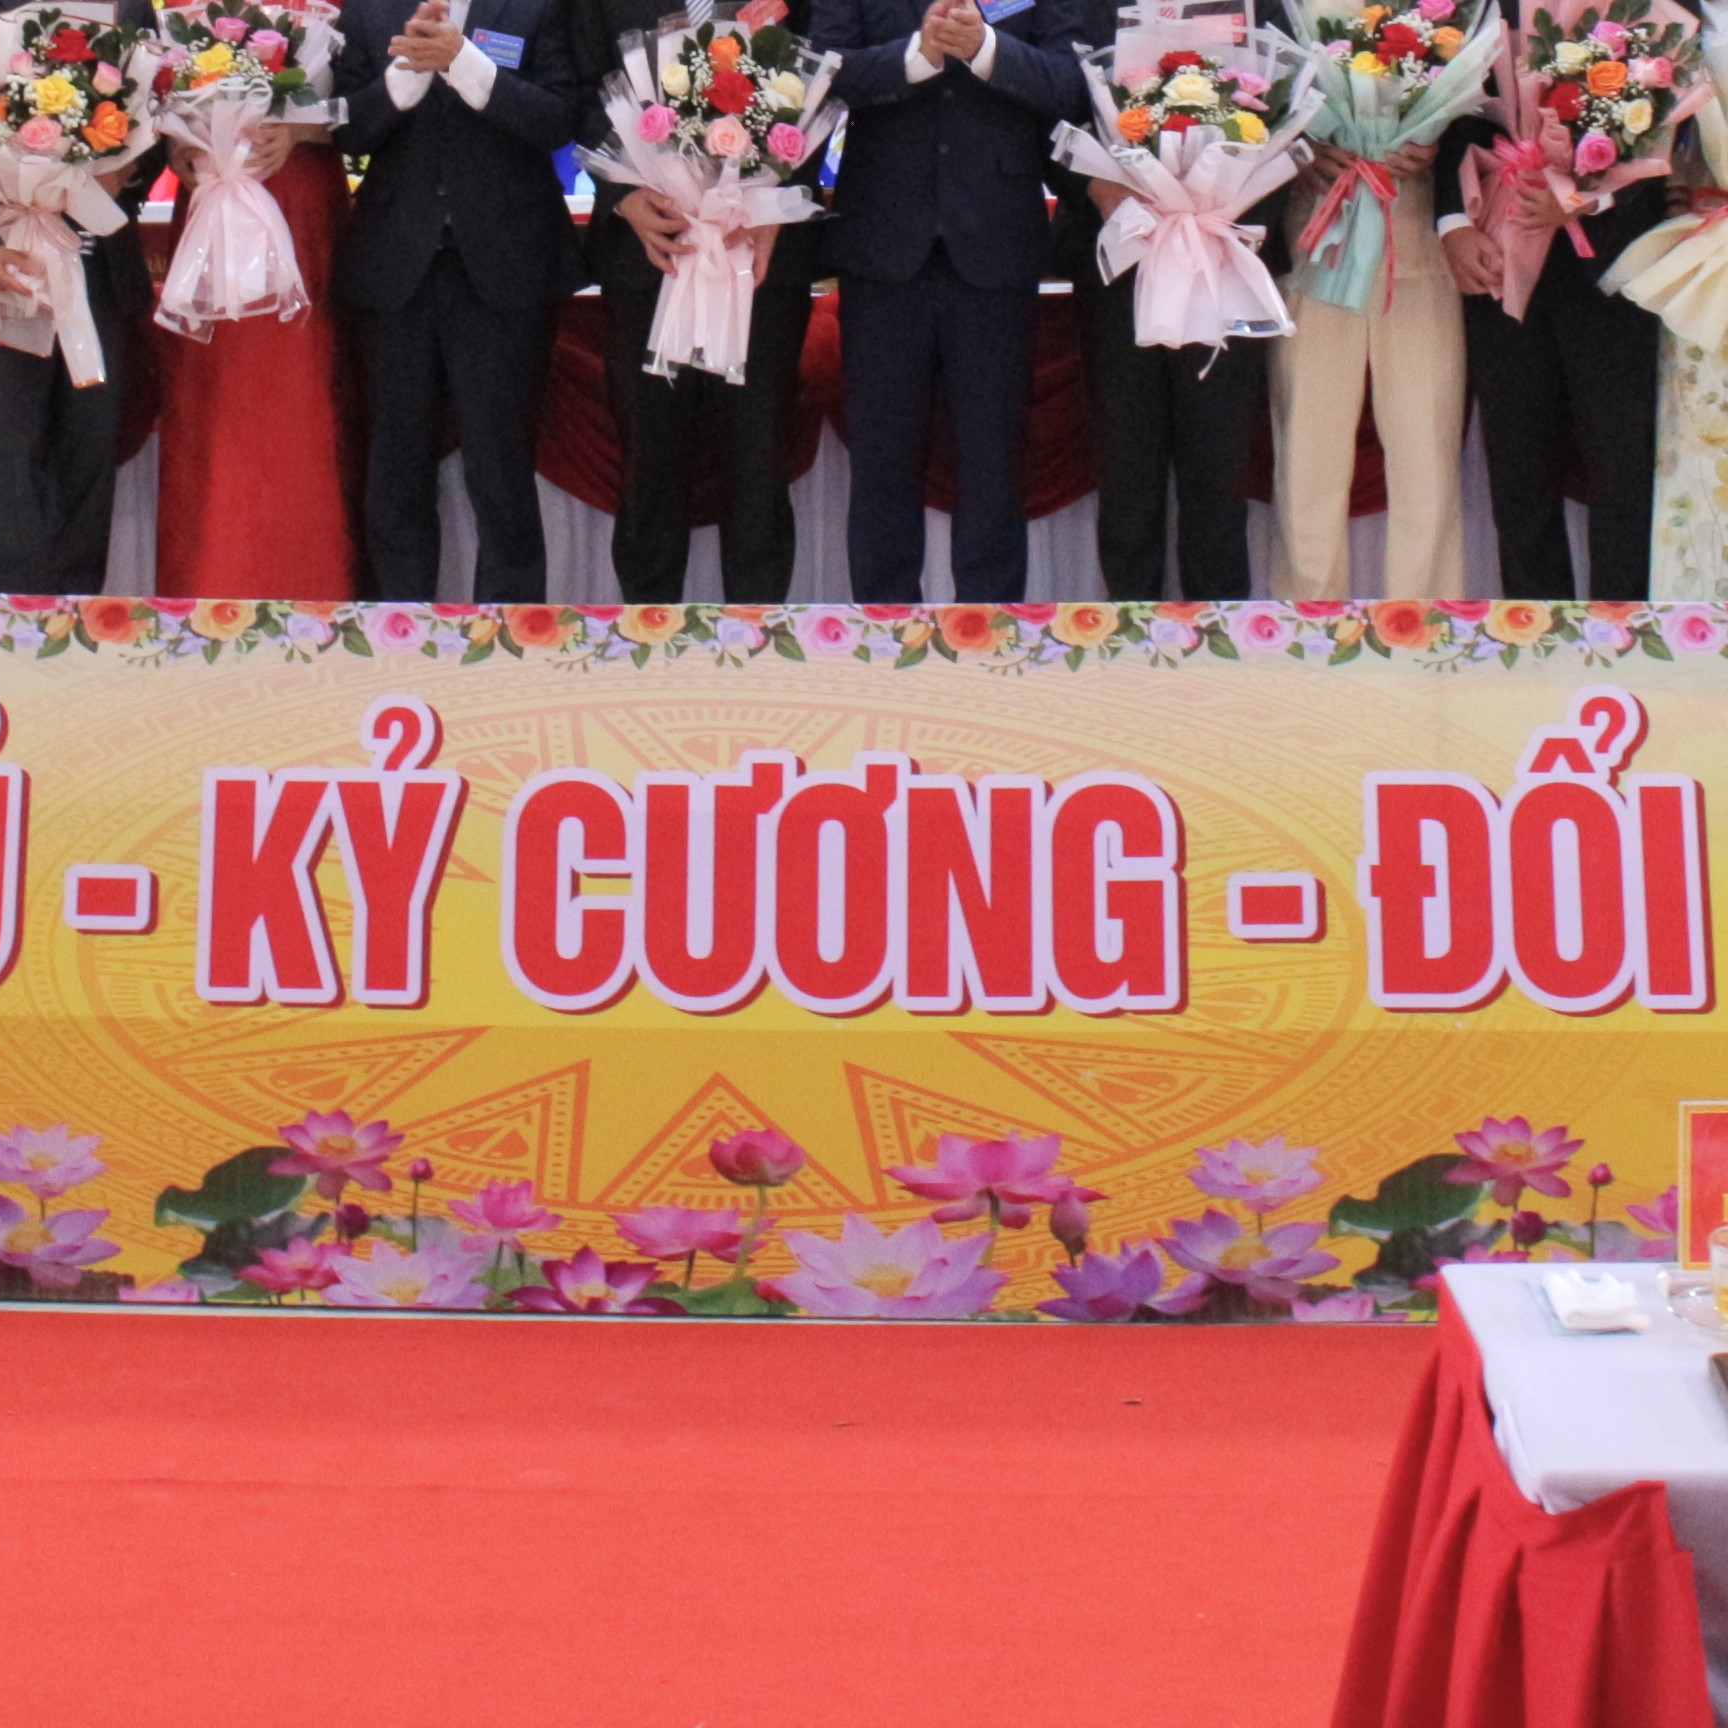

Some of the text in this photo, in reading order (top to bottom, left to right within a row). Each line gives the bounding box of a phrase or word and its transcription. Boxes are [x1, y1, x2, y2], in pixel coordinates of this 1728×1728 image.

[65, 863, 155, 932] -
[195, 694, 468, 1007] KỶ
[500, 748, 1183, 1014] CƯƠNG
[1227, 870, 1319, 942] -
[1361, 683, 1709, 1014] ĐỔI
